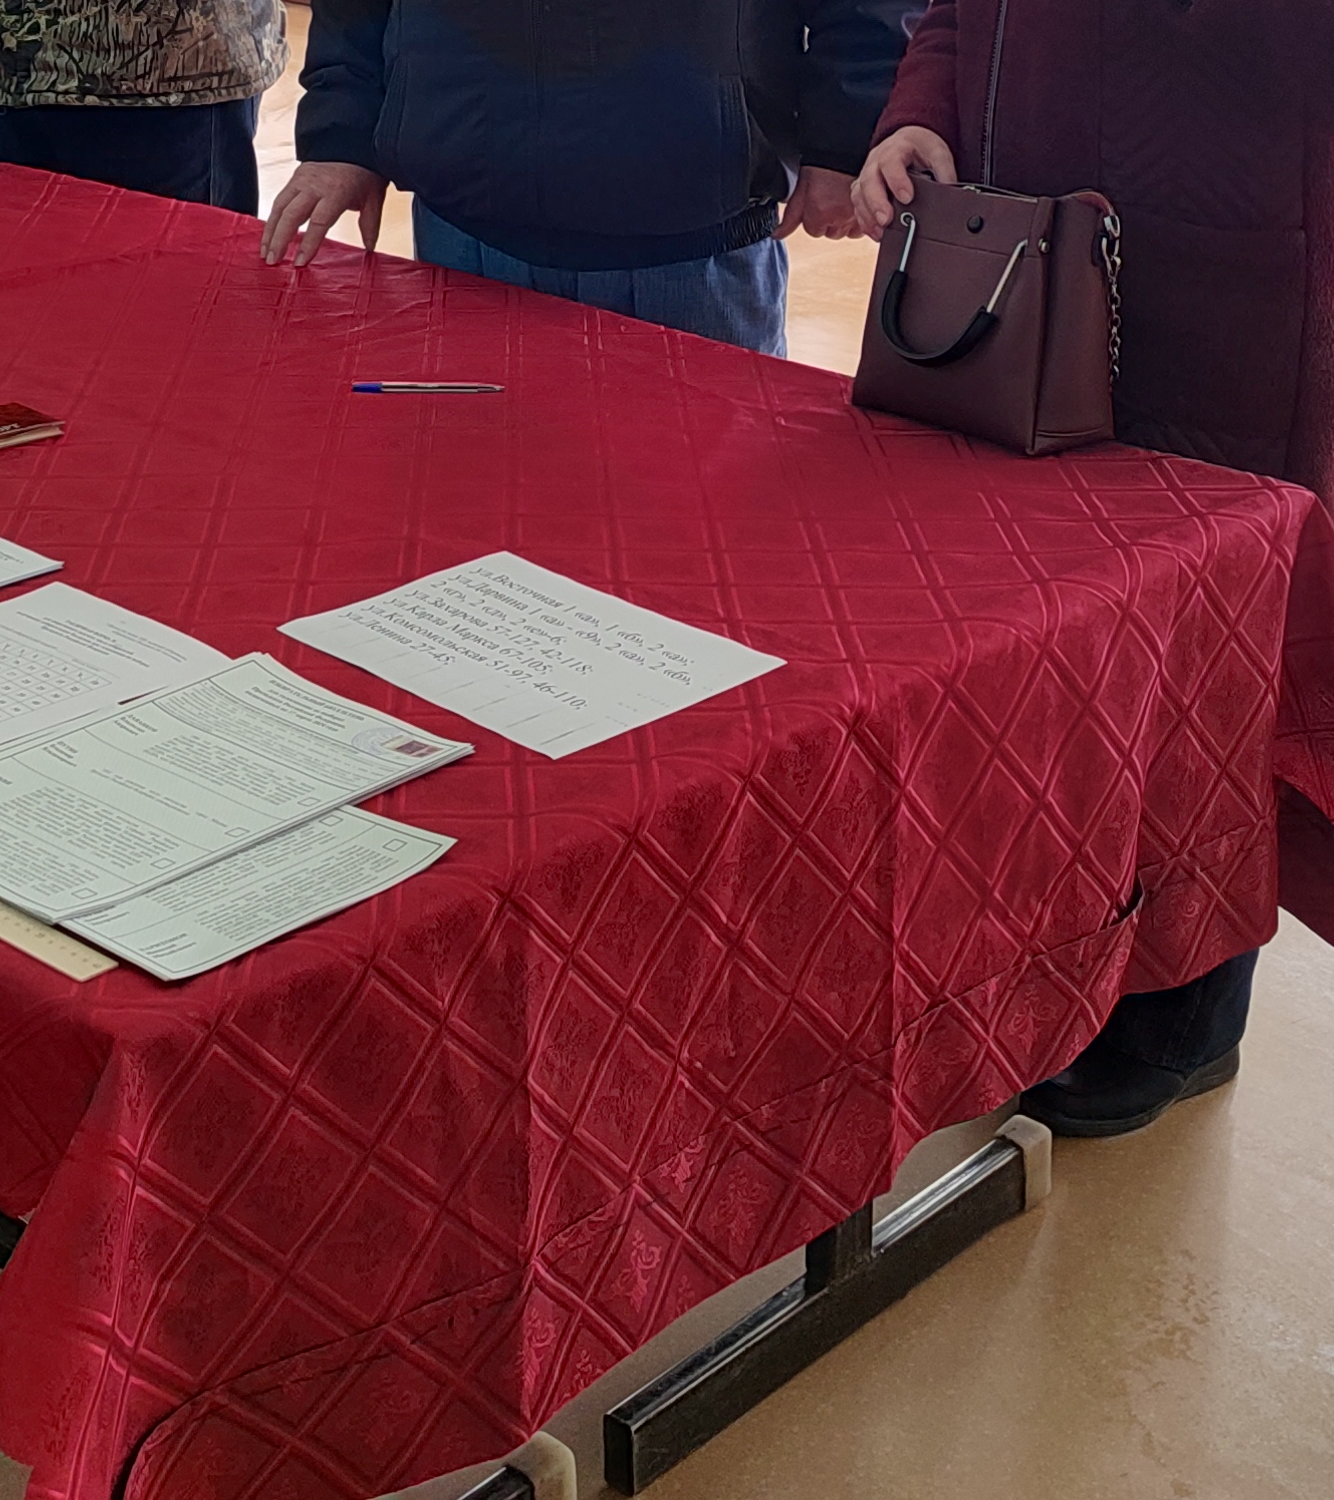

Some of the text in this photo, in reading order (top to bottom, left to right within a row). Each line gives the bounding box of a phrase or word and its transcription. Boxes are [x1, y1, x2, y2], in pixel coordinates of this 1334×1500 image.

[337, 611, 412, 644] ул.Ленина
[382, 597, 552, 675] ул.Карла Маркса 67-105;
[404, 589, 593, 675] ул.Захарова 57-127, 42-118;
[430, 580, 447, 588] 2
[468, 598, 485, 607] 2
[509, 618, 526, 626] 2
[447, 574, 528, 611] ул.Дарвина
[528, 607, 542, 615] 1
[604, 642, 621, 650] 2
[648, 661, 666, 670] 2
[468, 567, 563, 608] ул.Восточная
[574, 612, 599, 627] «а»,
[616, 631, 643, 647] «б»,
[646, 643, 664, 651] 2
[360, 604, 587, 710] ул.Комсомольская 51-97, 46-110;
